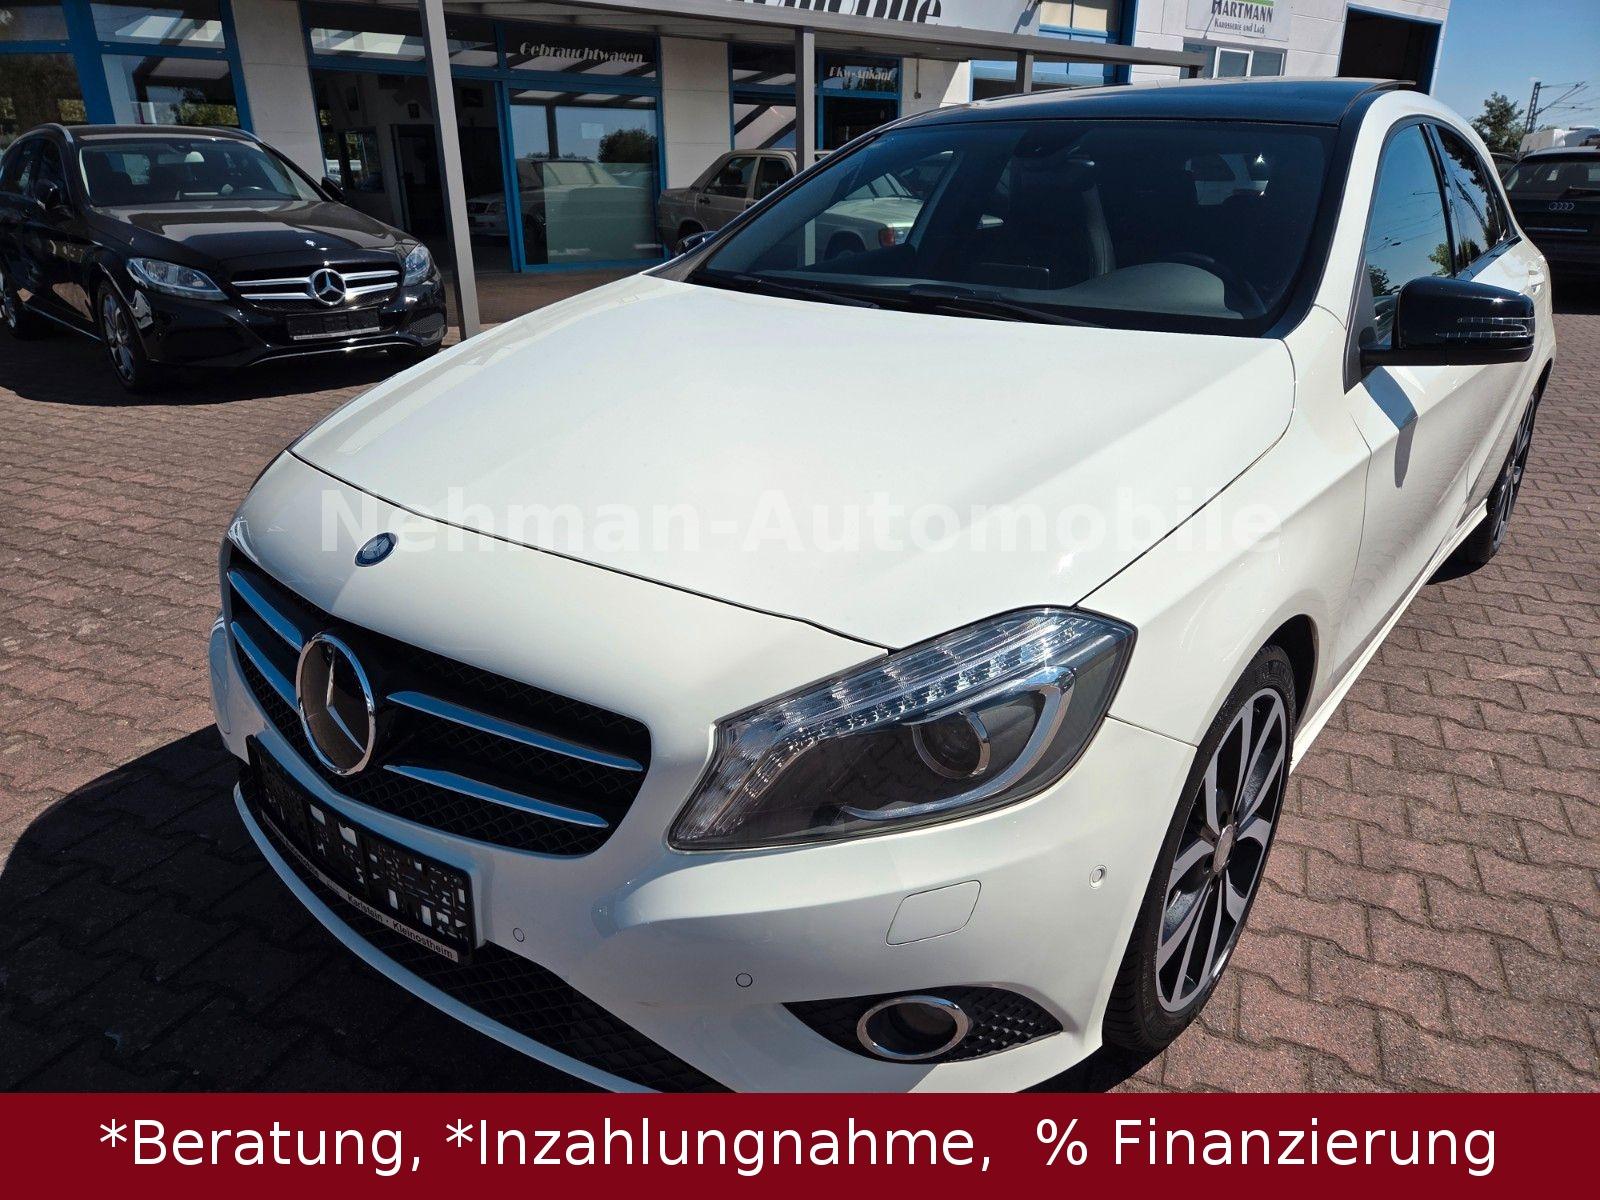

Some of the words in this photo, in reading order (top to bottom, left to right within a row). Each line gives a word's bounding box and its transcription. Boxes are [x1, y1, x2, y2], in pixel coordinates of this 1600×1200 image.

[1211, 0, 1274, 23] HARTMANN
[520, 42, 643, 62] Gebrauchtwagen
[393, 921, 453, 958] Kleinostheim
